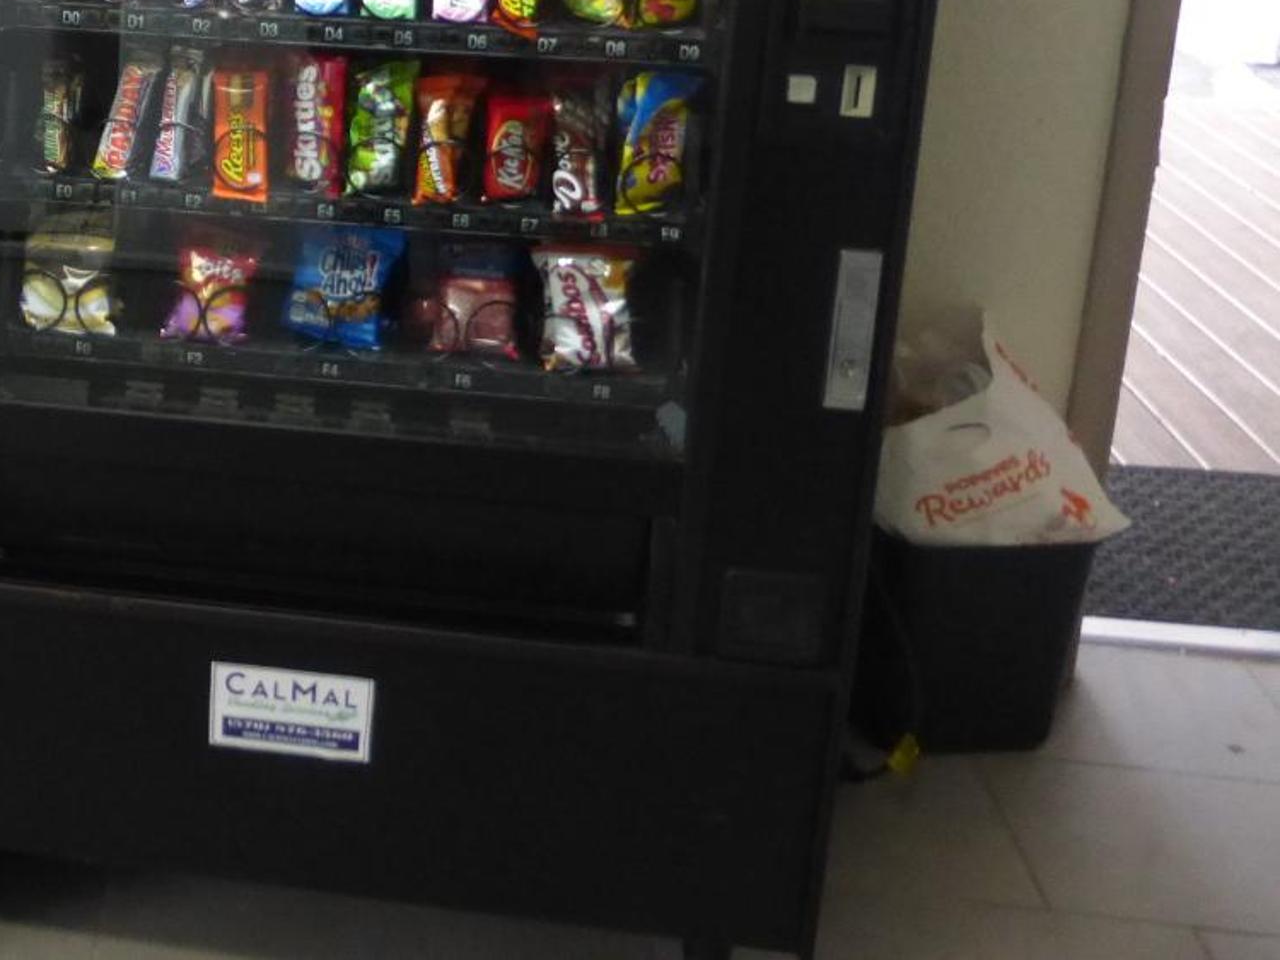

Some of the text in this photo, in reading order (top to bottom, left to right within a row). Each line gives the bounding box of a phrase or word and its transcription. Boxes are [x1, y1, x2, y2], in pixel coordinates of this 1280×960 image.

[62, 10, 81, 25] D0
[127, 14, 145, 28] D1
[324, 26, 343, 41] D4
[468, 34, 487, 49] D6
[537, 38, 557, 53] D7
[679, 45, 700, 60] D9
[915, 447, 1052, 528] Rewards
